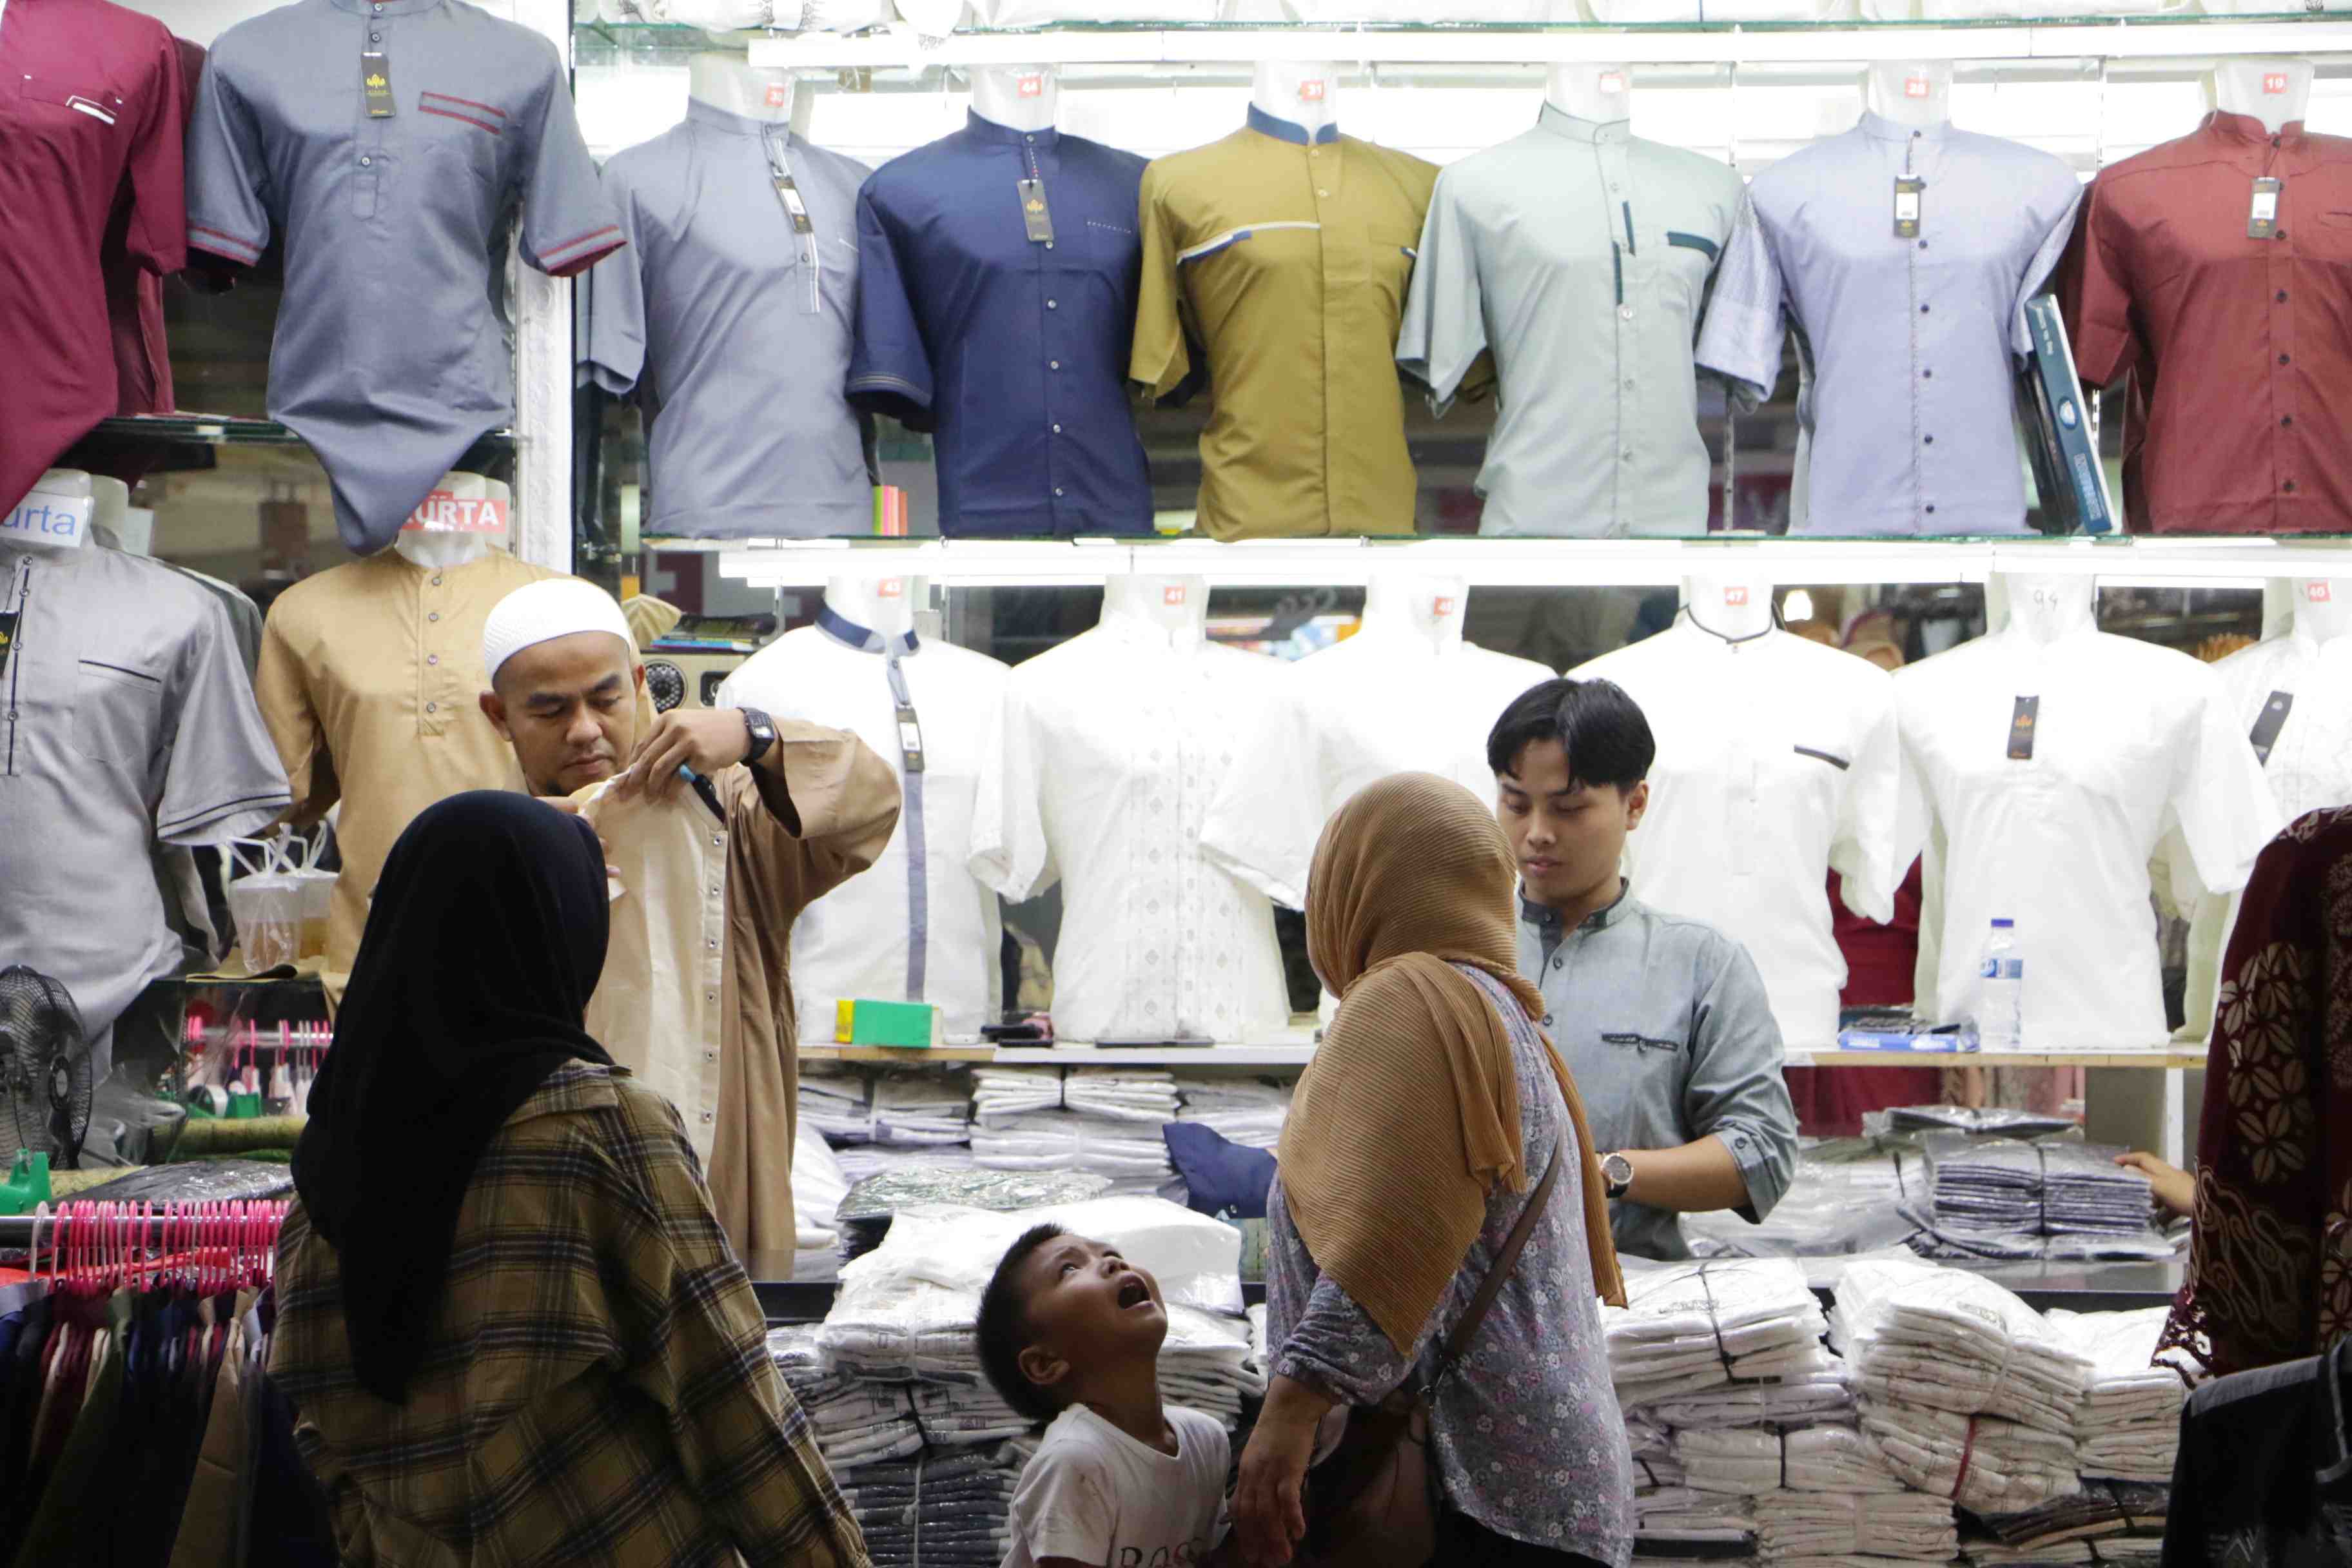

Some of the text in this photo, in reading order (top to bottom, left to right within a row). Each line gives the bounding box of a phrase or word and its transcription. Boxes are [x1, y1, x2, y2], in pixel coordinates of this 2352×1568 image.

[1021, 81, 1037, 93] 44
[407, 501, 500, 527] URTA
[2, 505, 76, 537] urta
[1727, 589, 1744, 602] 47
[2309, 586, 2326, 598] 40
